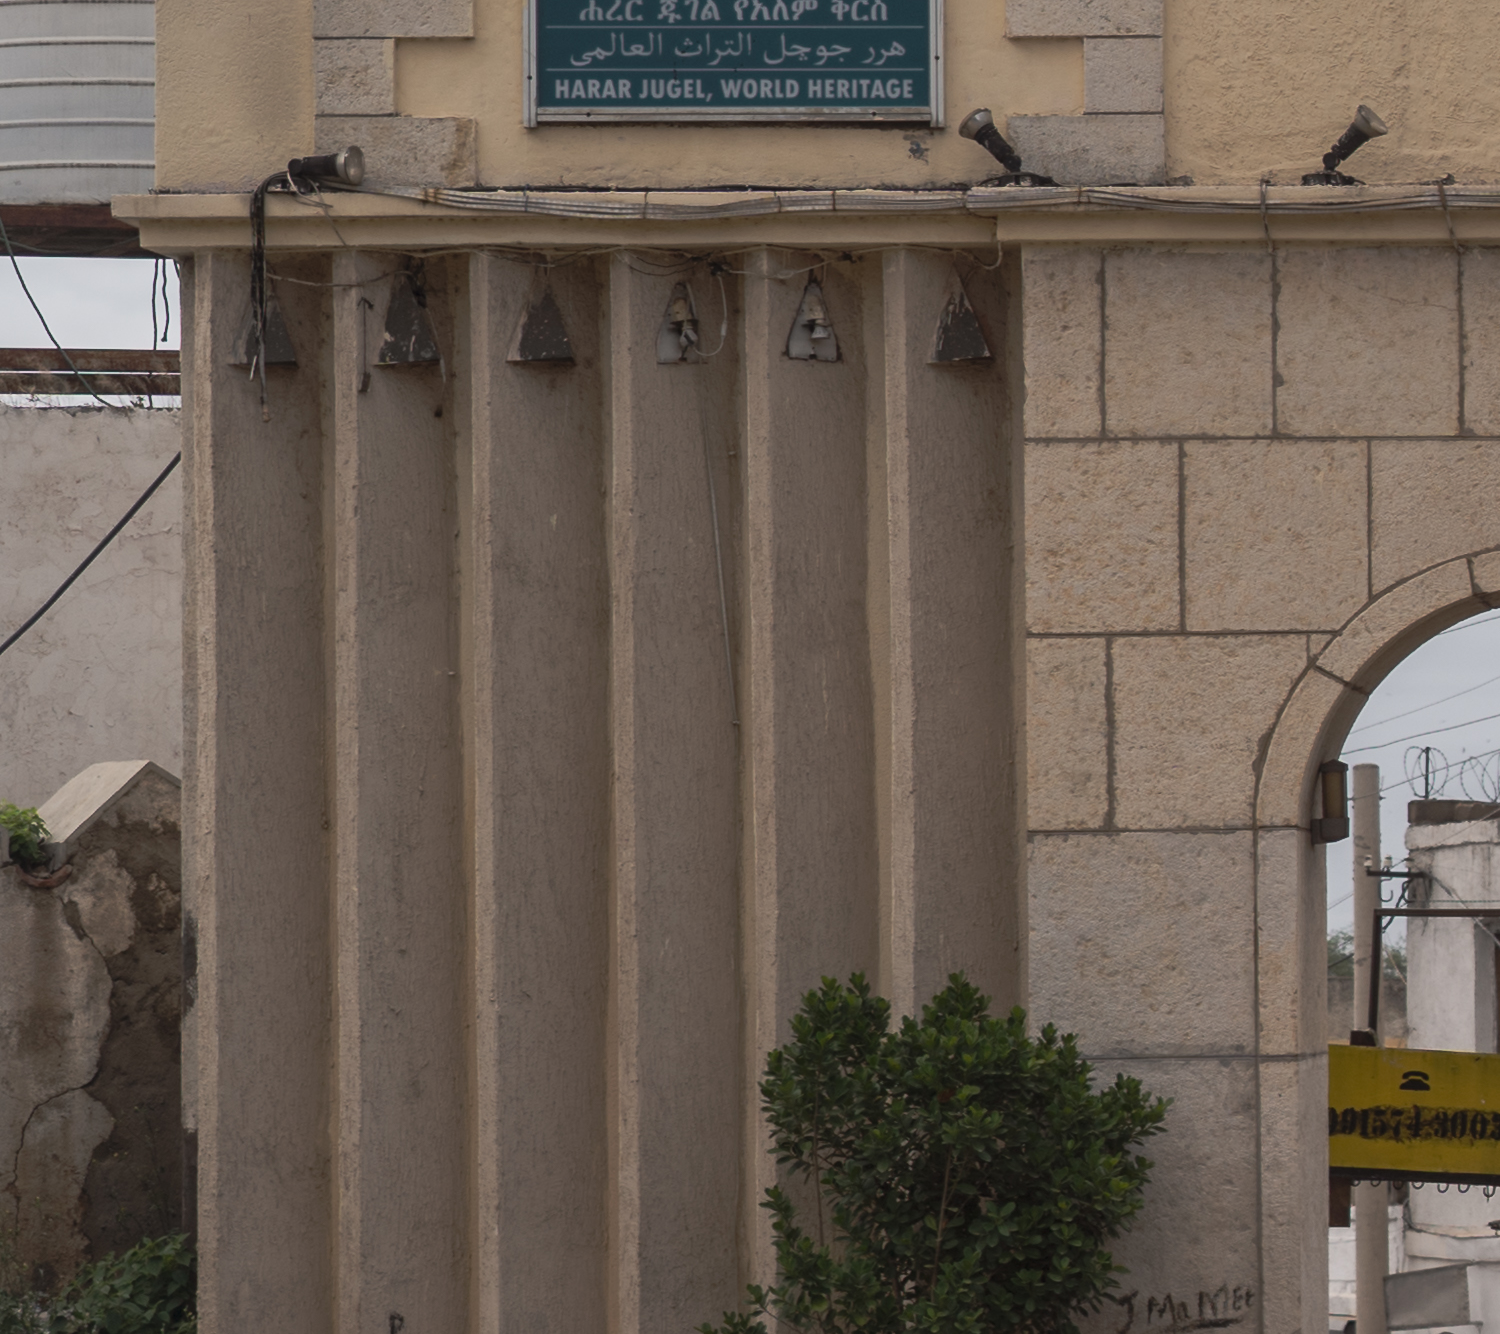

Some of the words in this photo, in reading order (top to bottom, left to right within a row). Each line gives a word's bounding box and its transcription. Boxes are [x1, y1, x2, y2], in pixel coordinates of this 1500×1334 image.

[674, 31, 752, 65] التراث
[861, 40, 906, 65] هرر
[555, 79, 630, 99] HARAR
[639, 79, 712, 101] JUGEL,
[720, 79, 798, 99] WORLD
[808, 79, 913, 99] HERITAGE
